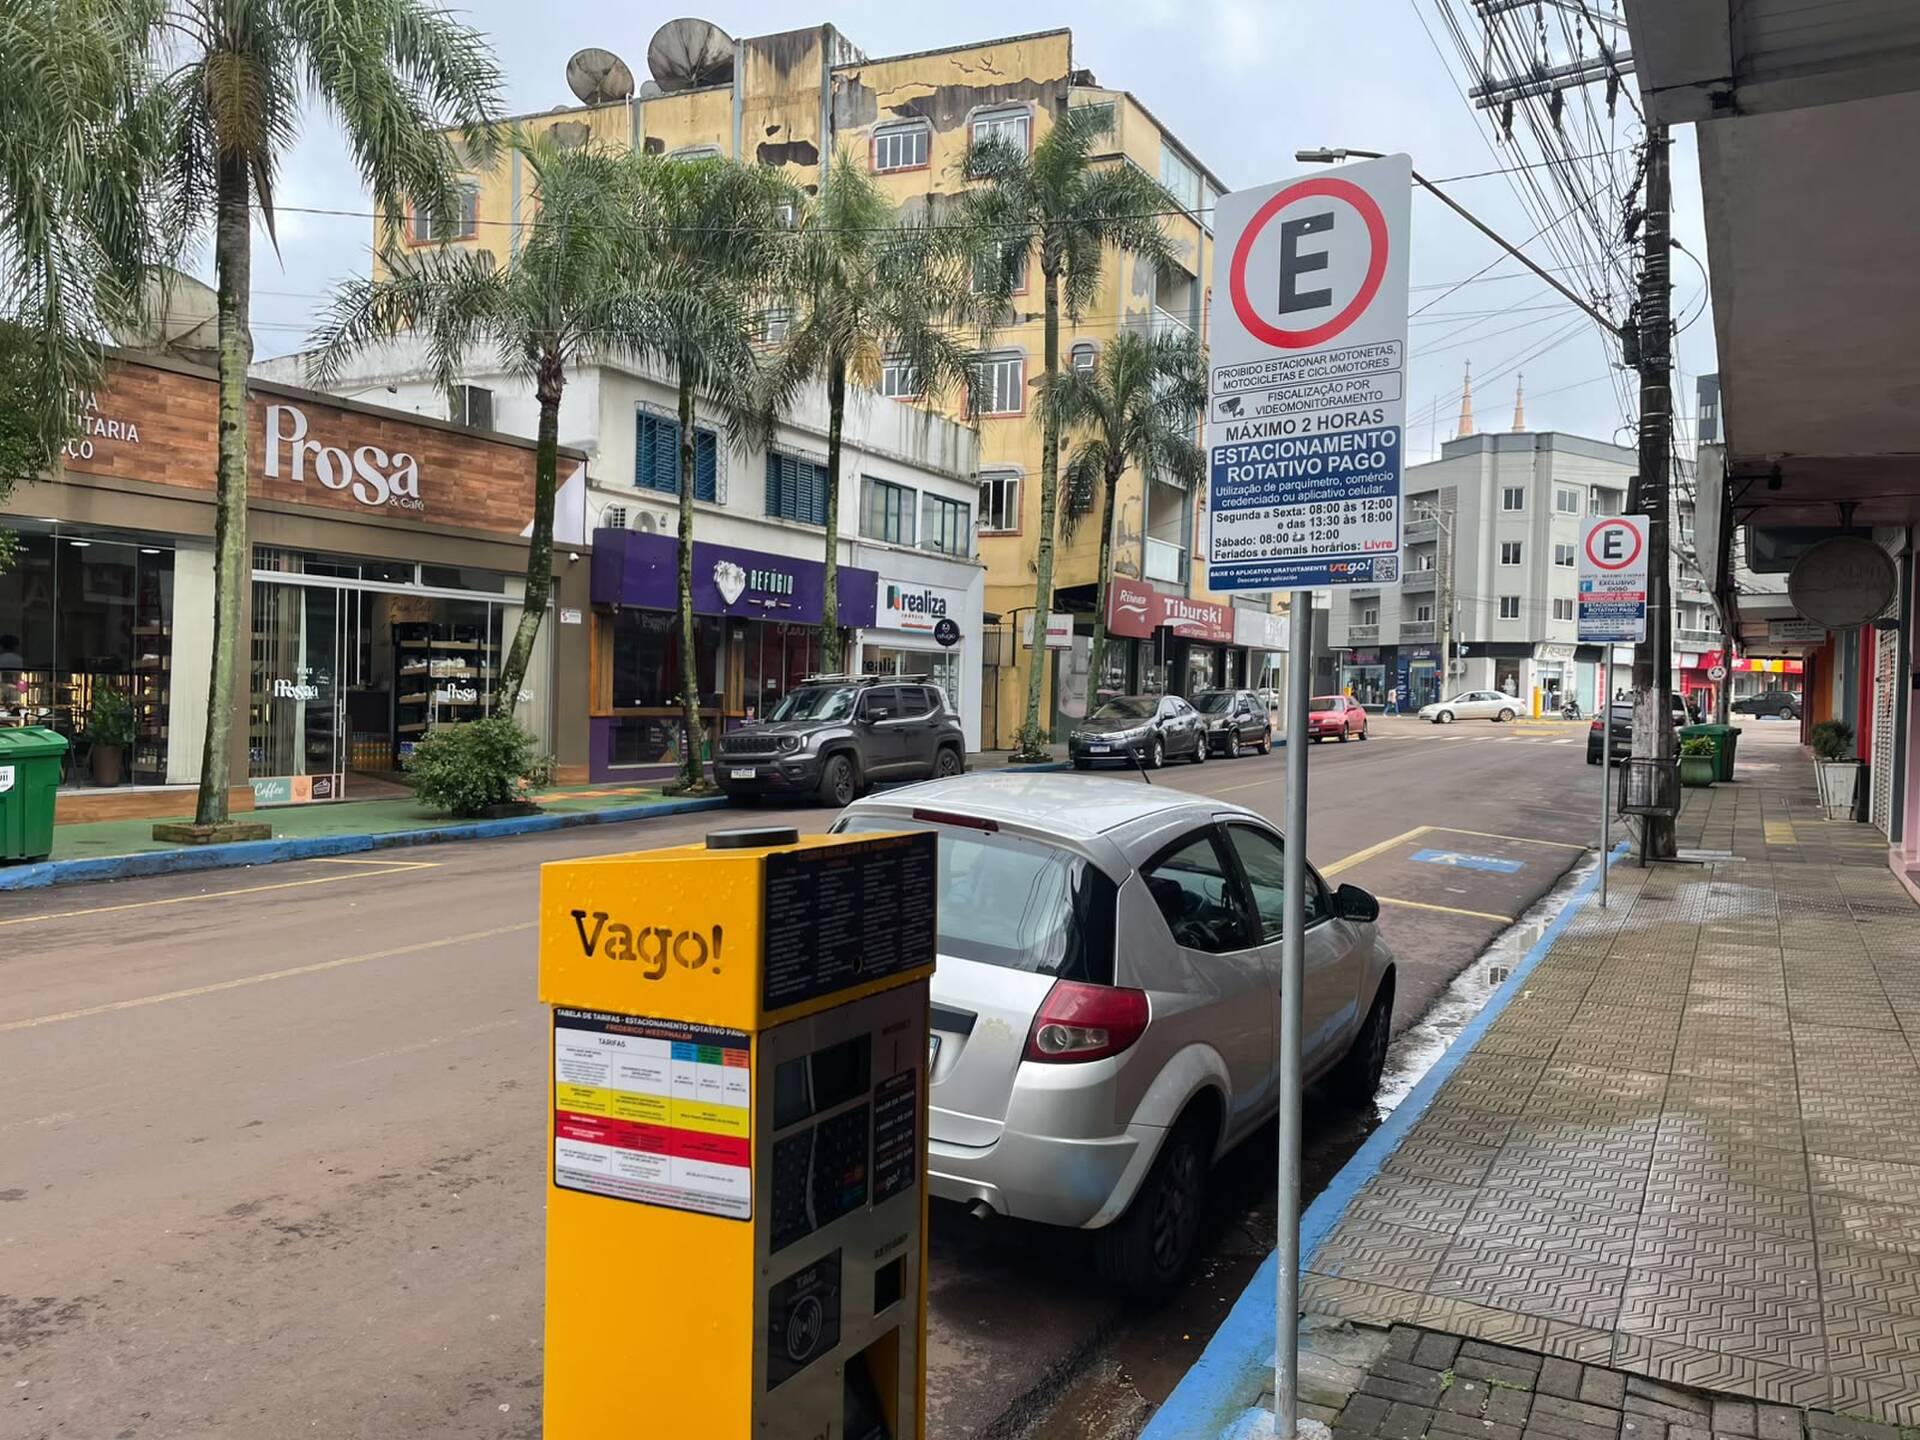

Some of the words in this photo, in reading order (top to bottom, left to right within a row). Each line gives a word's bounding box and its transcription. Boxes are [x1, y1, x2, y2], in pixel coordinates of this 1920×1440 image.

[1279, 211, 1334, 315] E
[1217, 364, 1262, 380] PROIBIDO
[1265, 354, 1326, 373] ESTACIONAR
[1329, 345, 1396, 362] MOTONETAS,
[1223, 372, 1296, 390] MOTOCICLETAS
[1298, 370, 1305, 380] E
[1307, 357, 1389, 378] CICLOMOTORES
[1255, 390, 1383, 415] VIDEOMONITORAMENTO
[1267, 381, 1343, 402] FISCALIZAÇÃO
[1346, 379, 1370, 391] POR
[1226, 419, 1296, 441] MÁXIMO
[1301, 417, 1311, 432] 2
[1317, 408, 1384, 430] HORAS
[1214, 430, 1396, 465] ESTACIONAMENTO
[1227, 457, 1322, 483] ROTATIVO
[1328, 451, 1386, 472] PAGO
[1216, 484, 1261, 497] Utilização
[1263, 482, 1276, 492] de
[1345, 470, 1394, 484] comércio
[1221, 494, 1279, 508] credenciado
[1282, 493, 1295, 502] ou
[1298, 488, 1346, 504] aplicativo
[1348, 484, 1385, 496] celular.
[1216, 509, 1261, 524] Segunda
[1263, 511, 1270, 519] a
[1273, 506, 1305, 518] Sexta:
[1309, 503, 1340, 516] 08:00
[1343, 502, 1357, 513] às
[1360, 498, 1393, 511] 12:00
[1277, 522, 1284, 530] e
[1286, 517, 1305, 529] das
[1310, 516, 1340, 528] 13:30
[1343, 514, 1357, 525] às
[1361, 511, 1393, 524] 18:00
[1214, 547, 1258, 560] Feriados
[1261, 548, 1268, 556] e
[1270, 544, 1308, 556] demais
[1311, 540, 1361, 553] horários:
[1364, 539, 1393, 550] Livre
[1215, 534, 1256, 548] Sábado:
[1259, 532, 1289, 545] 08:00
[1309, 529, 1340, 541] 12:00
[1603, 530, 1623, 559] E
[1210, 569, 1229, 578] BAIXE
[1229, 568, 1235, 577] O
[1235, 567, 1272, 576] APLICATIVO
[1272, 564, 1327, 574] GRATUITAMENTE
[1329, 559, 1372, 576] vago!
[901, 590, 946, 614] realiza
[1164, 598, 1222, 624] Tiburski
[255, 782, 285, 798] Coffee
[571, 909, 723, 981] Vago!
[557, 1008, 581, 1019] TABELA
[582, 1011, 592, 1020] DE
[594, 1012, 621, 1023] TARIFAS
[625, 1016, 689, 1031] ESTACIONAMENTO
[689, 1023, 725, 1036] ROTATIVO
[605, 1024, 644, 1036] FREDERICO
[598, 1037, 626, 1048] TARIFAS
